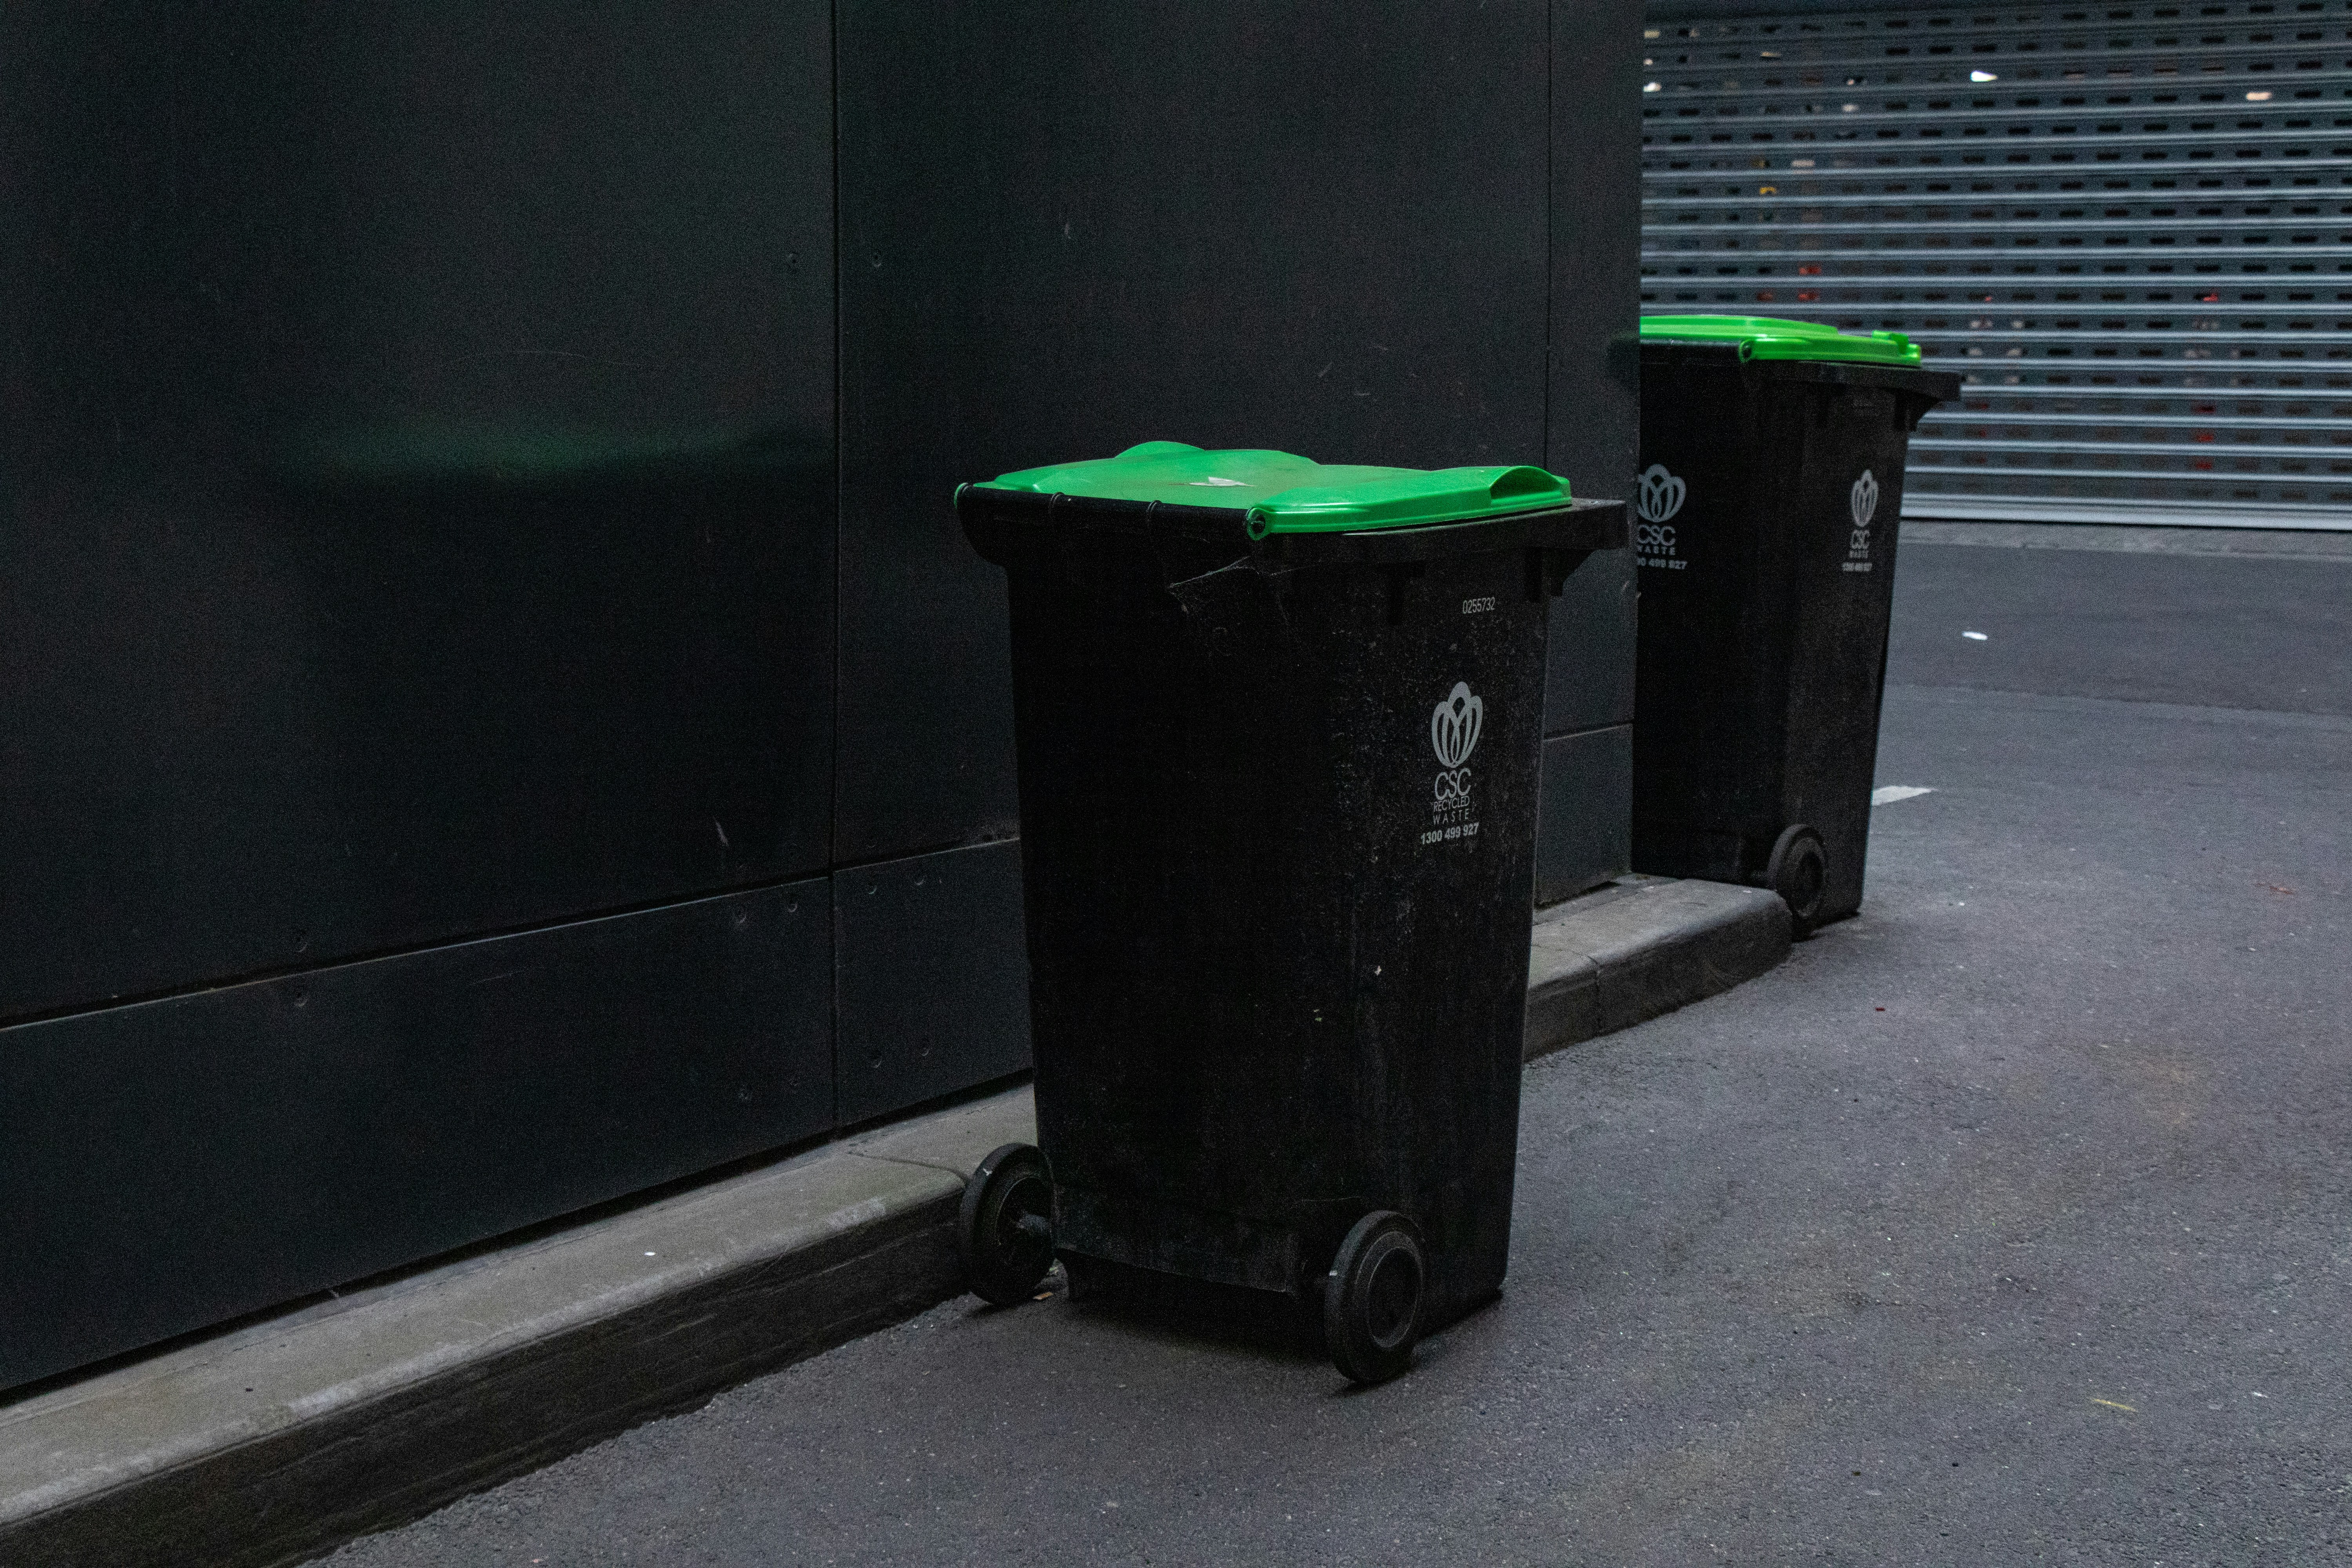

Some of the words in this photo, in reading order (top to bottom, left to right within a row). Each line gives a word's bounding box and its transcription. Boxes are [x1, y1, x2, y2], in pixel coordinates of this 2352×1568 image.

[1638, 524, 1676, 546] CSC
[1463, 597, 1495, 614] 0255732
[1435, 768, 1471, 800] CSC
[1433, 796, 1470, 812] RECYCLED
[1433, 808, 1470, 825] WASTE
[1421, 830, 1443, 844] 1300
[1444, 826, 1461, 839] 499
[1463, 822, 1479, 836] 927
